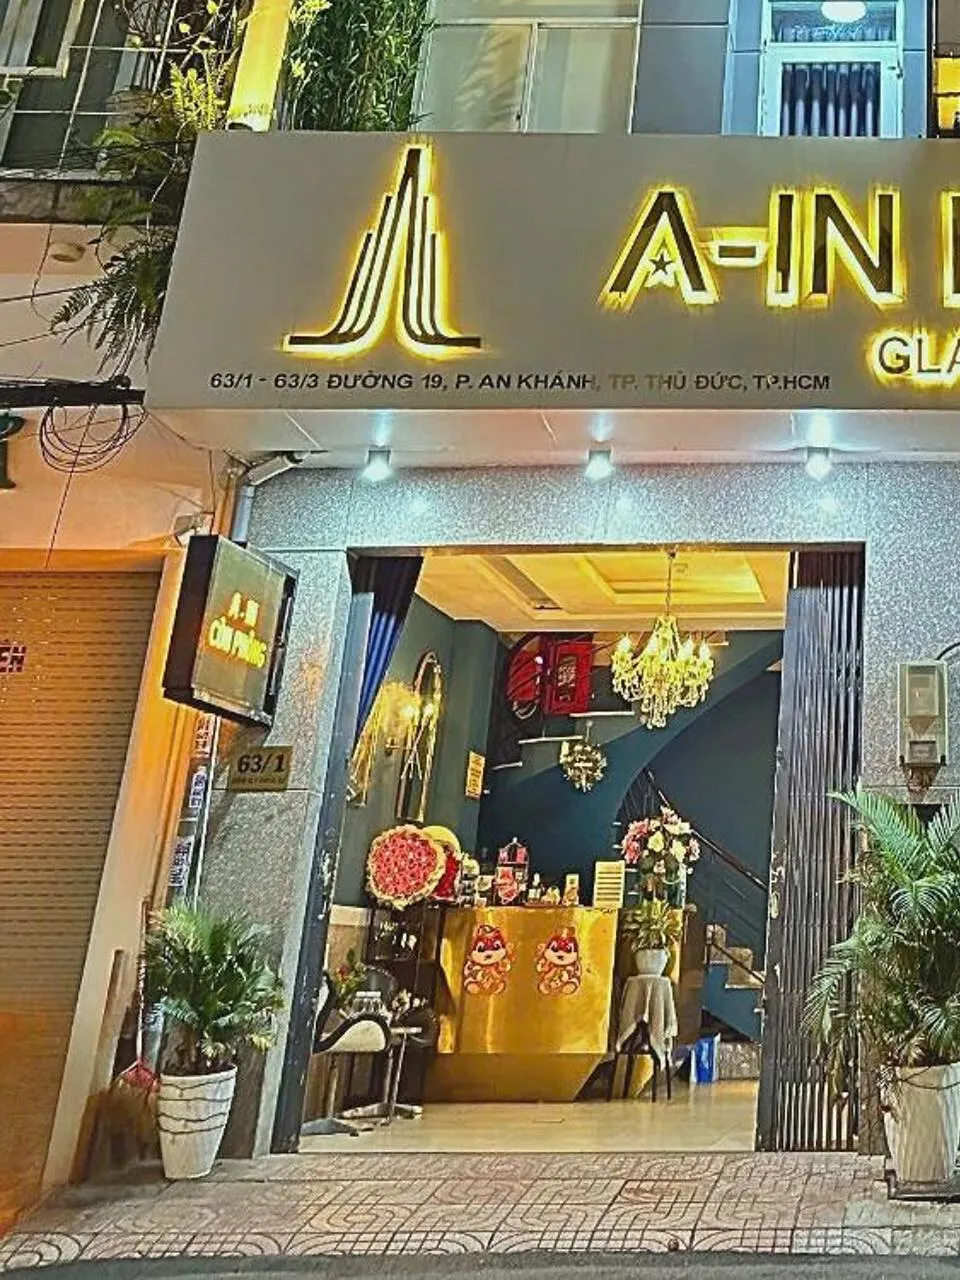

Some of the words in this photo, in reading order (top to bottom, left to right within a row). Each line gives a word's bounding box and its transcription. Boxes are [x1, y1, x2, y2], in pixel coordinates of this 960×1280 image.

[605, 190, 898, 298] A-IN
[210, 372, 254, 389] 63/1
[273, 372, 320, 389] 63/3
[326, 369, 414, 390] ĐƯỜNG
[420, 372, 448, 391] 19,
[455, 373, 473, 390] P.
[478, 373, 512, 390] AN
[516, 370, 600, 392] KHÁNH,
[608, 374, 638, 390] TP.
[644, 370, 687, 391] THỦ
[694, 371, 748, 392] ĐỨC,
[752, 374, 831, 391] TP.HCM
[238, 753, 286, 773] 63/1
